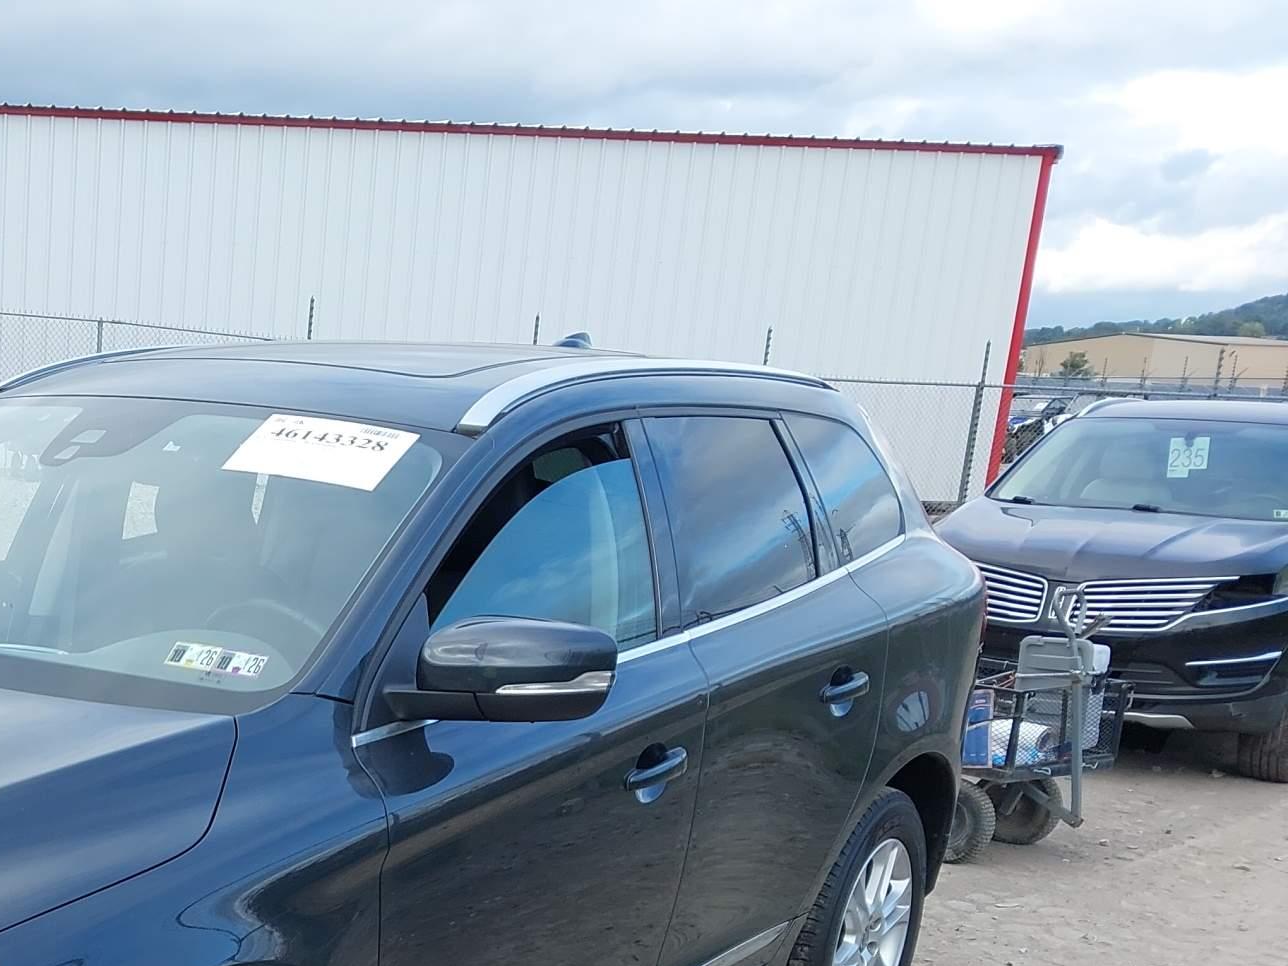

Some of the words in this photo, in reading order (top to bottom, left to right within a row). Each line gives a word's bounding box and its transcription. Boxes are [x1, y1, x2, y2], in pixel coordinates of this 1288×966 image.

[270, 427, 389, 452] 46143328
[1169, 447, 1206, 468] 235
[200, 649, 217, 666] 26
[247, 657, 265, 674] 26
